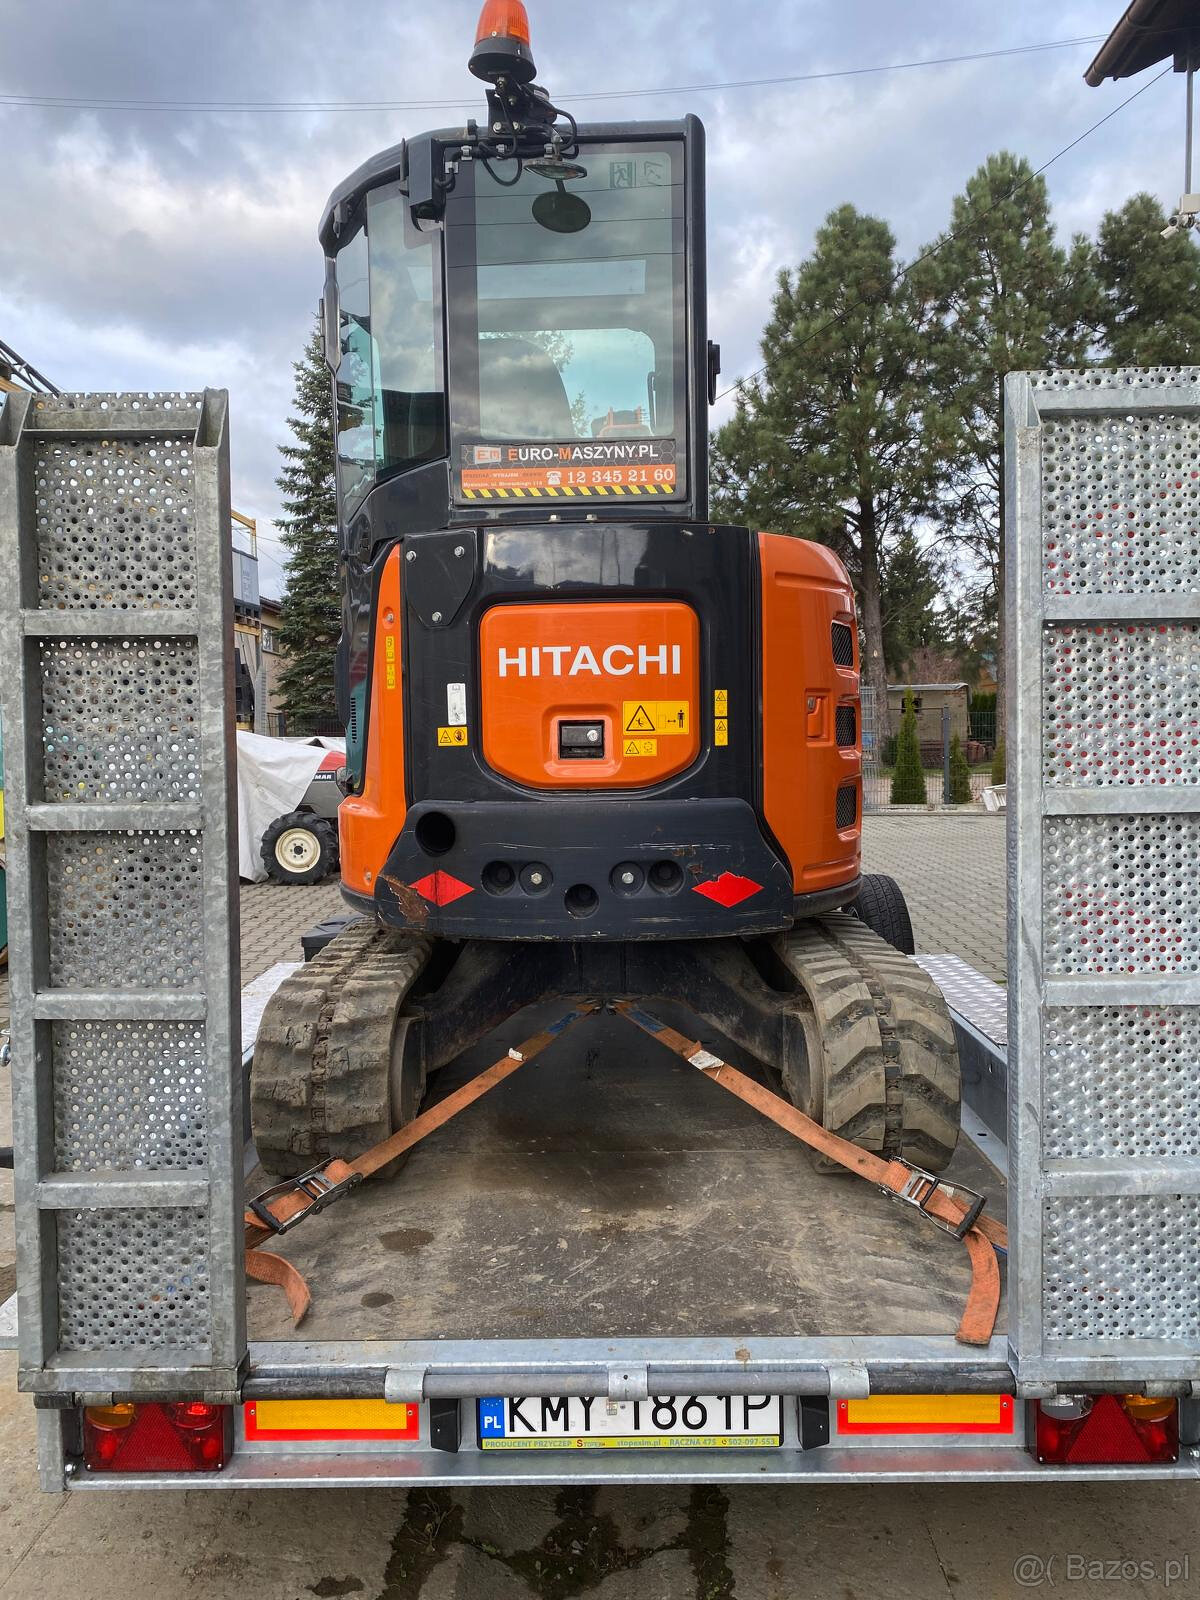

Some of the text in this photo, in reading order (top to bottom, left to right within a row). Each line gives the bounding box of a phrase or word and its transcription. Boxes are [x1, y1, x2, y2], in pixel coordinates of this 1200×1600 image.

[507, 445, 659, 461] EURO-MASZYNY.PL
[567, 468, 674, 484] 12 345 21 60
[498, 644, 681, 677] HITACHI
[508, 1396, 771, 1432] KMY 1861P
[484, 1416, 501, 1429] PL
[485, 1440, 531, 1448] PRODUCENT
